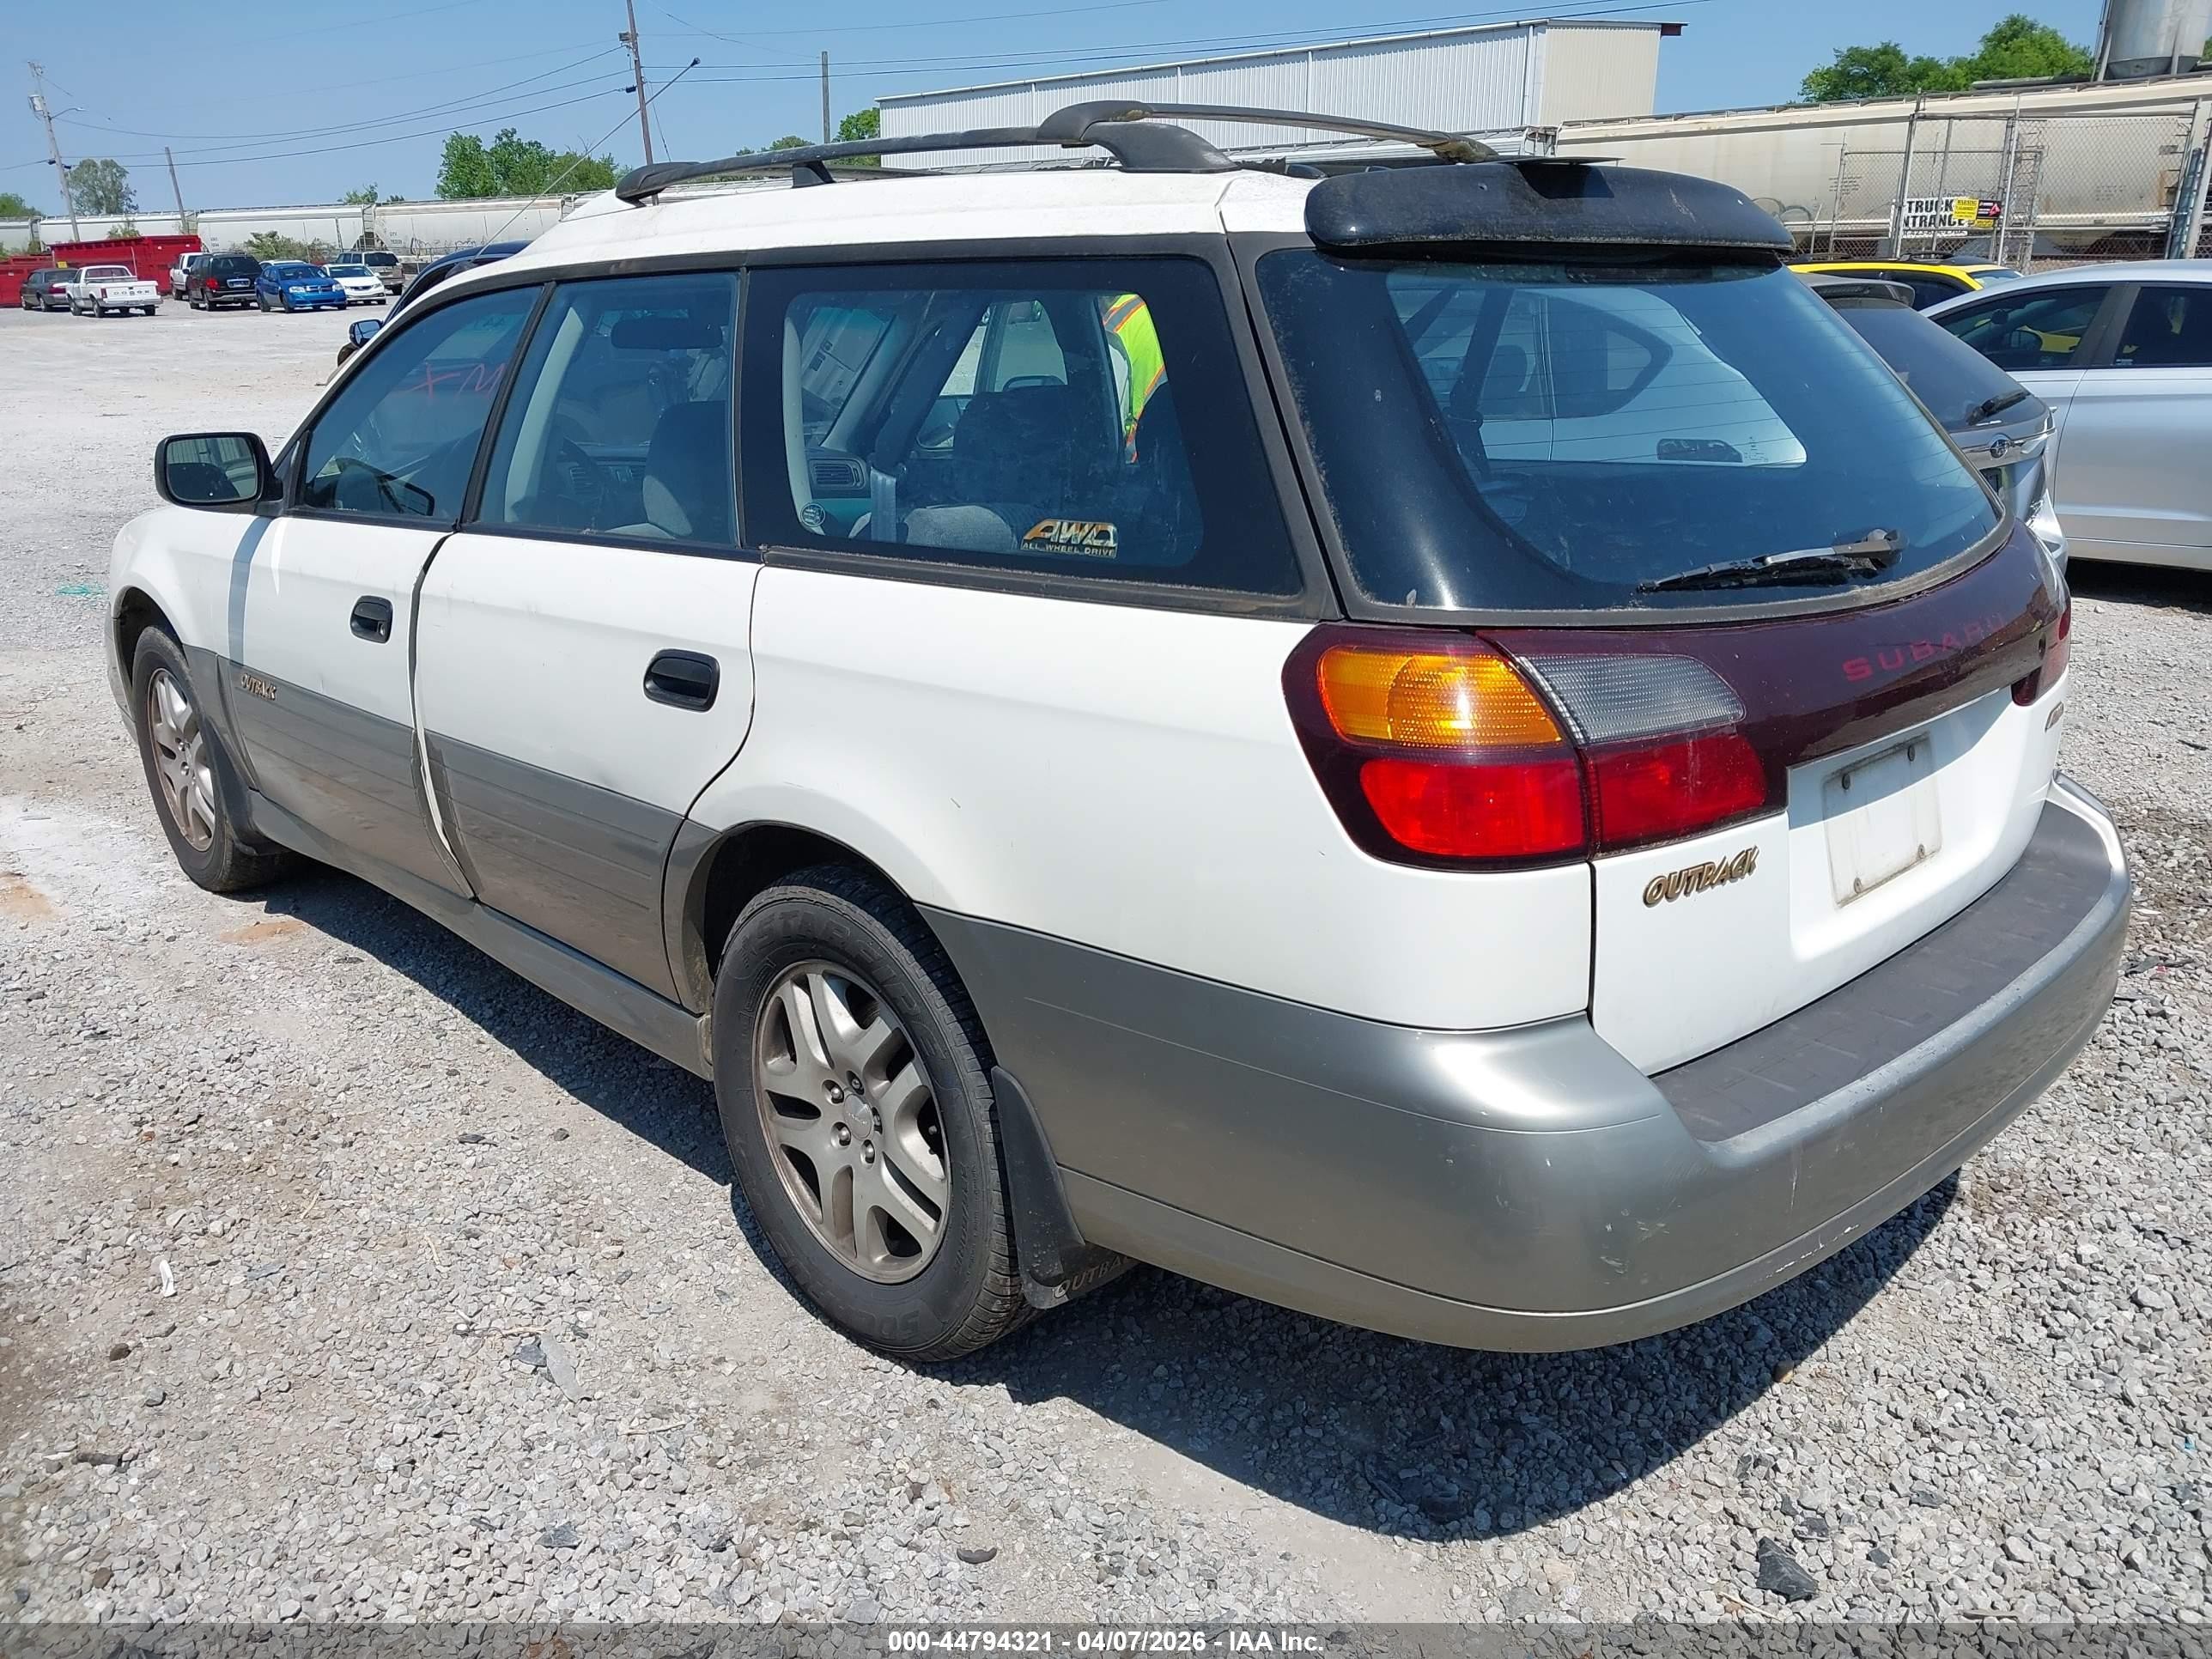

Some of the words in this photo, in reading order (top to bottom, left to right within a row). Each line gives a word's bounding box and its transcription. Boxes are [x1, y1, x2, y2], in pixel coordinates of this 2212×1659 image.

[1906, 198, 1954, 214] TRUCK
[1903, 213, 1966, 228] NTRANCE
[1023, 519, 1118, 547] AWD
[1045, 544, 1081, 554] WHEEL
[1084, 548, 1115, 557] DRIVE
[1842, 612, 2006, 682] SUBARU
[240, 672, 276, 701] OUTBACK
[1643, 845, 1759, 908] OUTBACK
